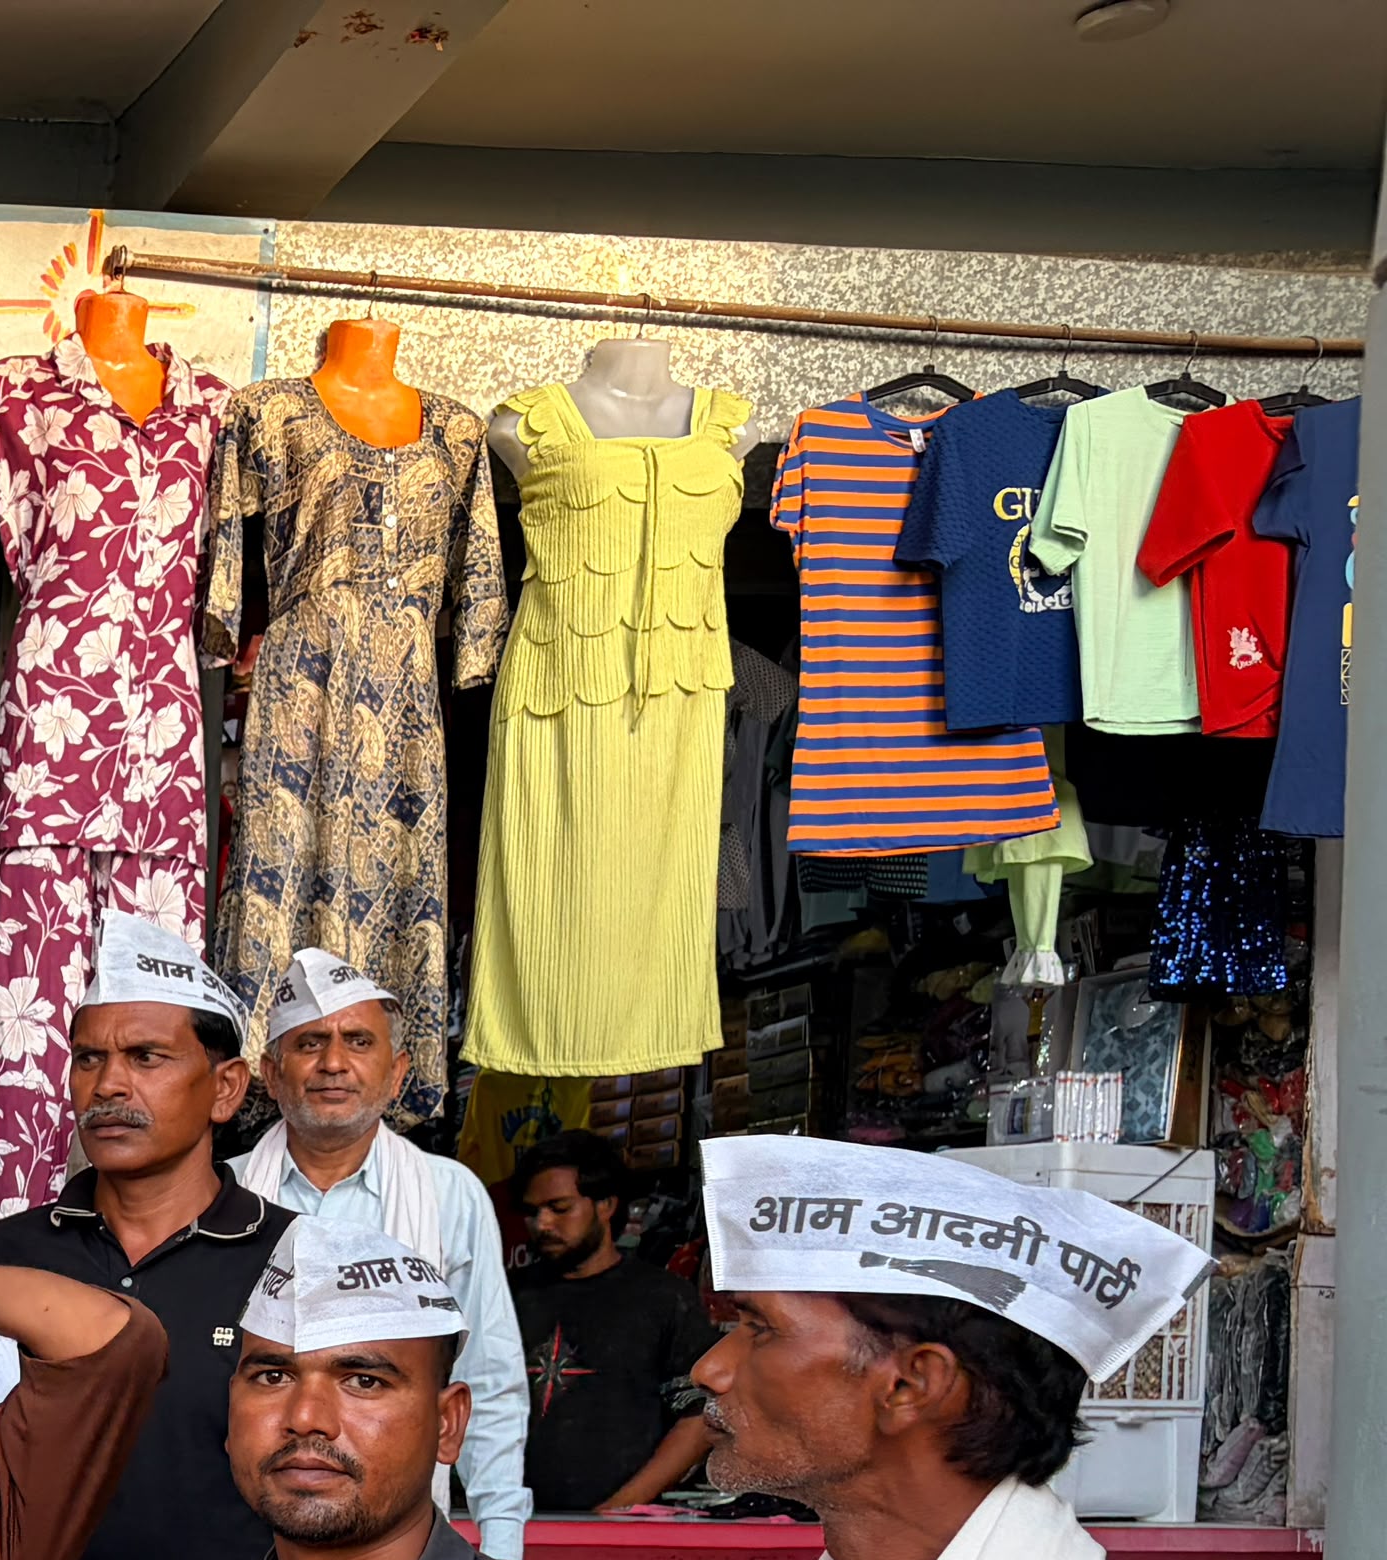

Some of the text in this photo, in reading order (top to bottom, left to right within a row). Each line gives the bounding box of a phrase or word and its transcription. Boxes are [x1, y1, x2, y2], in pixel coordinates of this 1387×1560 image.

[137, 953, 195, 982] आम
[748, 1196, 1142, 1311] आम आदमी पार्टी
[337, 1257, 403, 1291] आम
